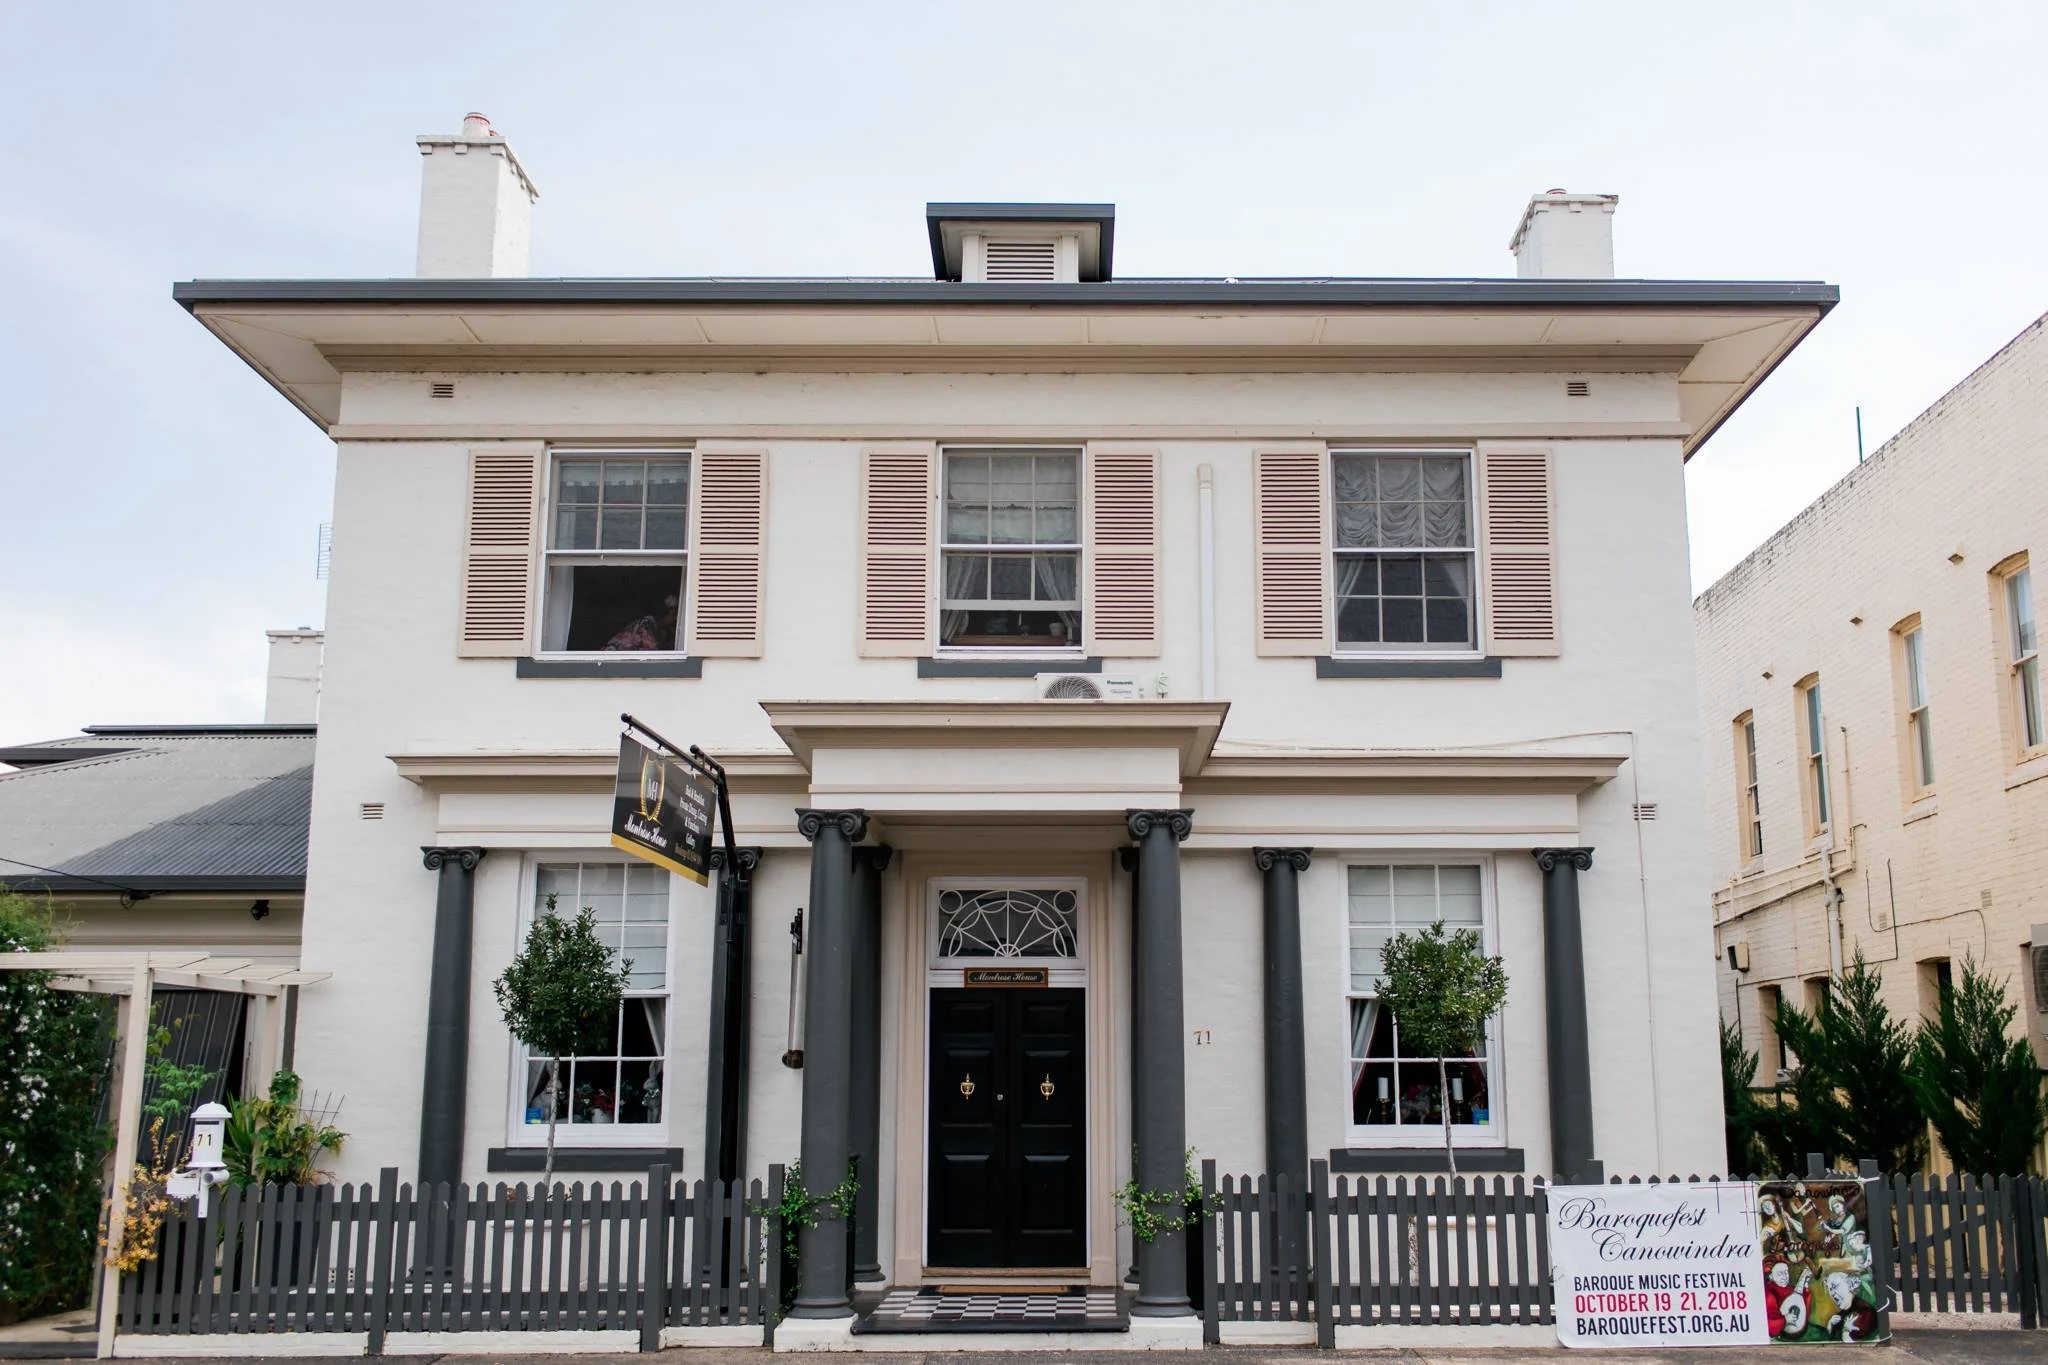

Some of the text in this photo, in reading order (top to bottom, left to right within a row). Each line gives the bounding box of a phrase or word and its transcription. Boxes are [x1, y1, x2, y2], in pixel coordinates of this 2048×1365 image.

[974, 971, 1038, 981] Montrose House
[1193, 1029, 1211, 1046] 71
[197, 1133, 212, 1147] 71
[1558, 1197, 1707, 1239] Baroquefest
[1591, 1228, 1753, 1263] Canowindra
[1573, 1272, 1746, 1292] BAROQUE MUSIC FESTIVAL
[1575, 1290, 1748, 1313] OCTOBER 19 21. 2018
[1576, 1314, 1750, 1336] BAROQUEFEST.ORG.AU
